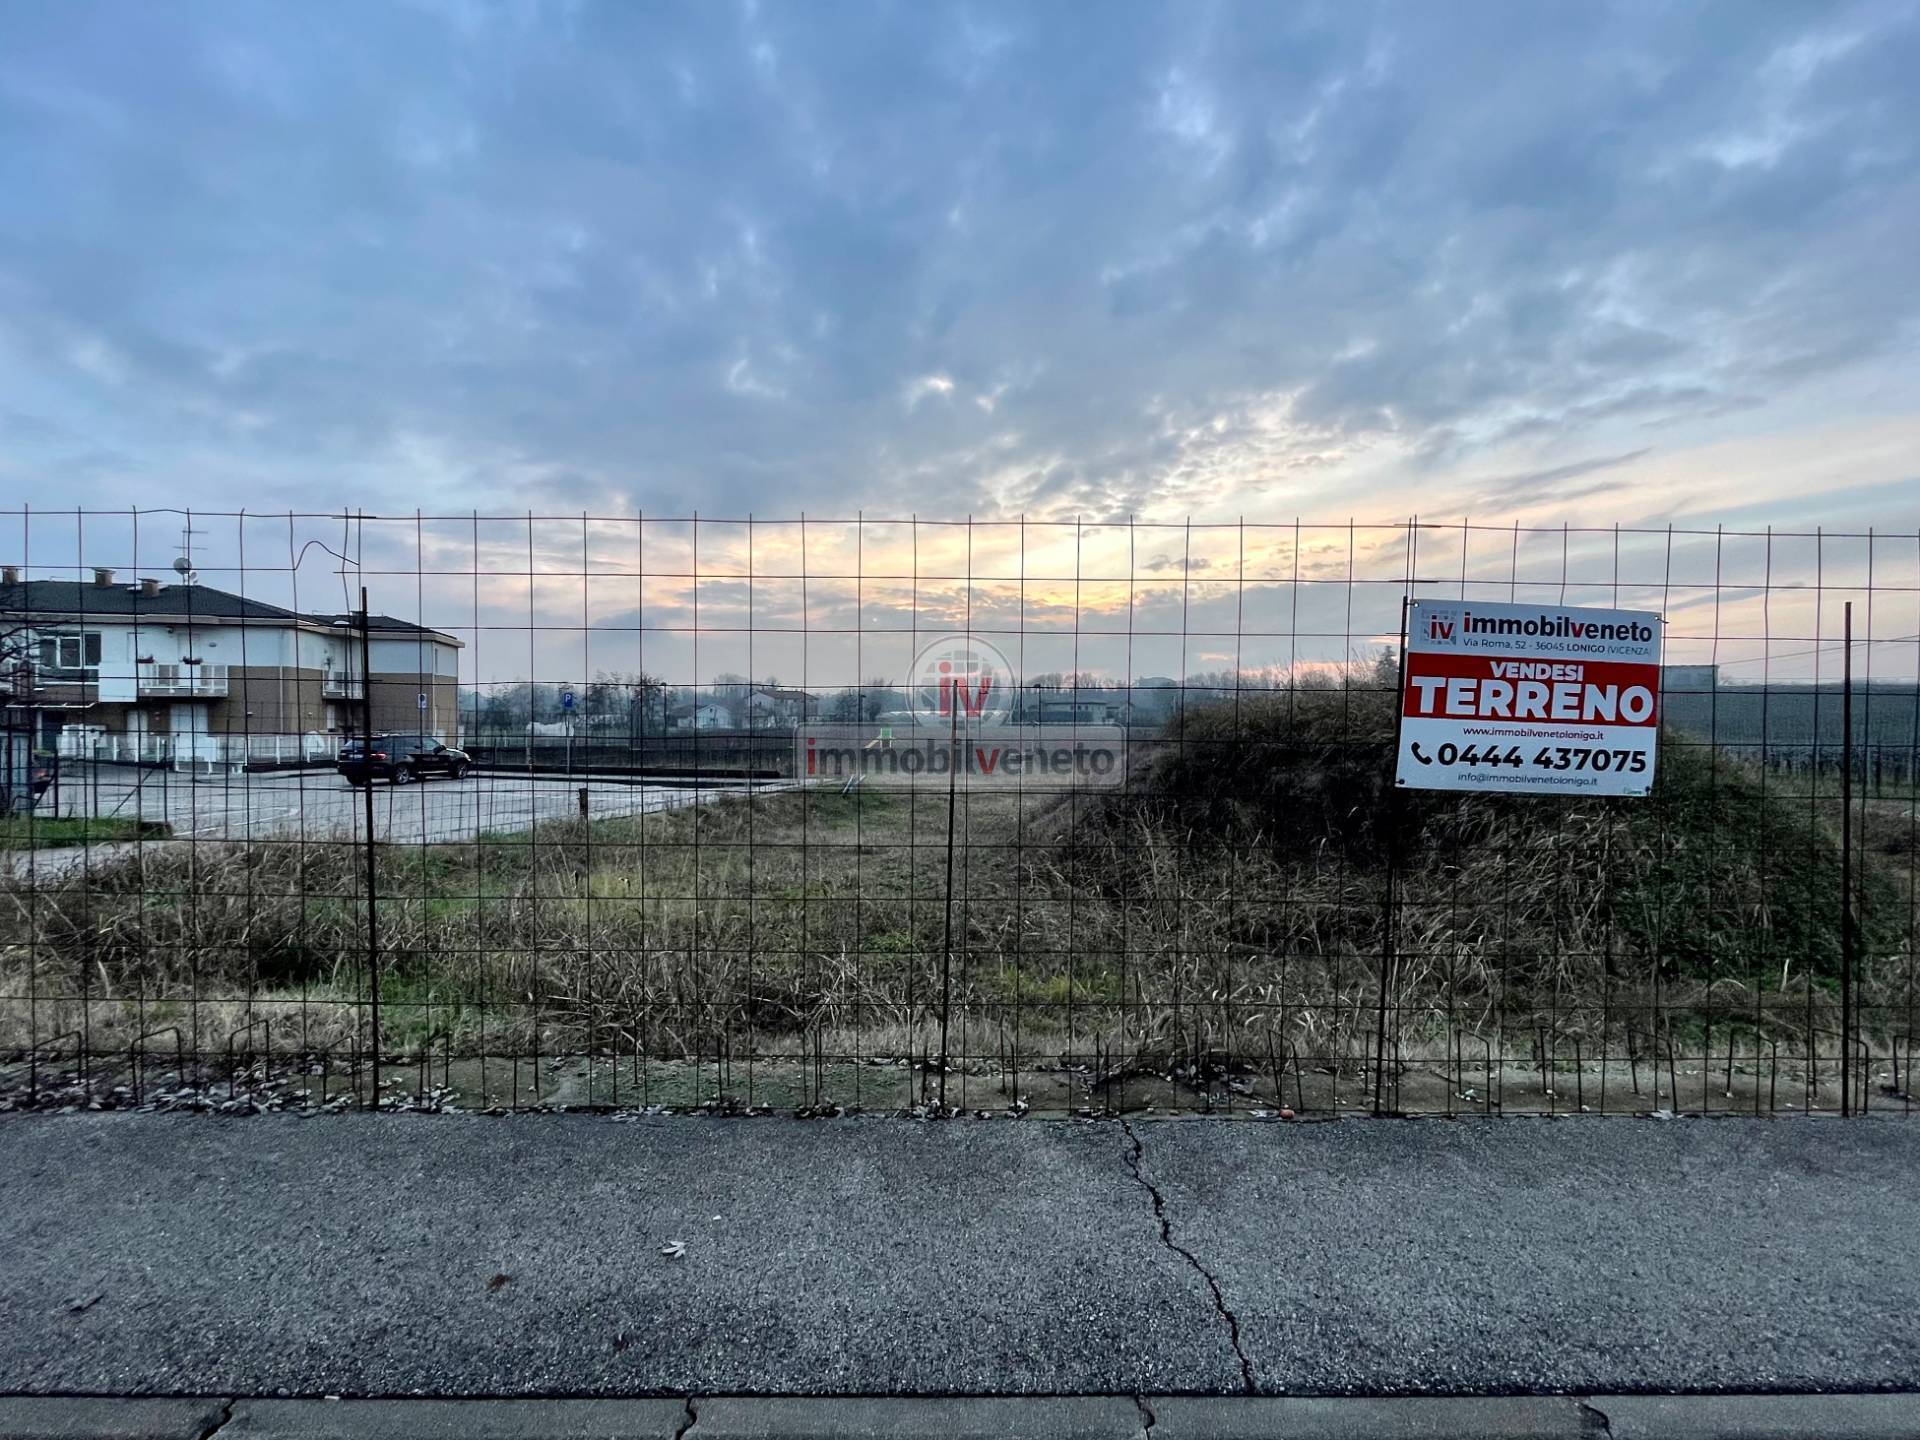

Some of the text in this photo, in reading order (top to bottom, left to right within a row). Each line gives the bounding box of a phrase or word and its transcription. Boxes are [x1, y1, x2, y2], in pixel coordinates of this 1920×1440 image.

[1463, 611, 1652, 642] immobilveneto
[1463, 638, 1478, 647] Via
[1481, 639, 1513, 649] Roma,
[1515, 640, 1526, 649] 52
[1535, 641, 1564, 651] 36045
[1566, 643, 1605, 653] LONIGO
[1490, 661, 1584, 682] VENDESI
[1411, 676, 1654, 723] TERRENO
[1462, 727, 1604, 741] www.immobilvenetolonigo.it
[1437, 742, 1647, 773] 0444 437075
[1458, 772, 1598, 787] info@immobilvenetolonigo.it
